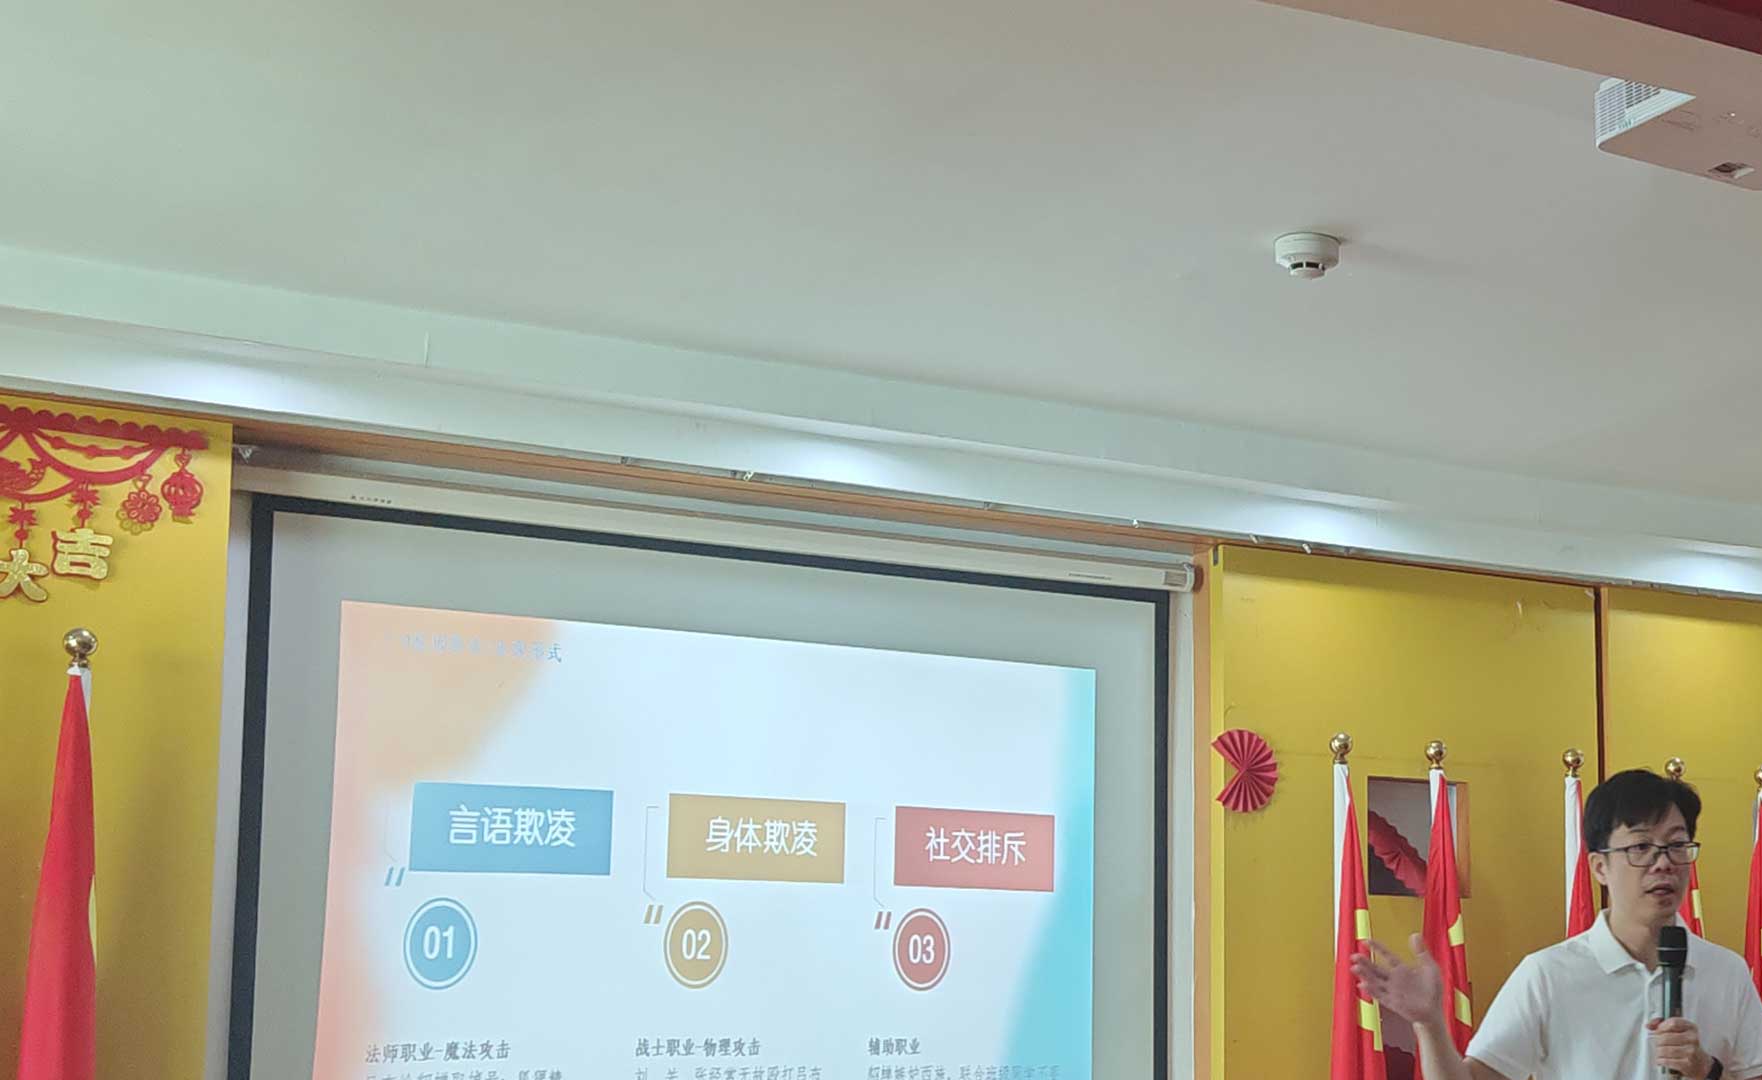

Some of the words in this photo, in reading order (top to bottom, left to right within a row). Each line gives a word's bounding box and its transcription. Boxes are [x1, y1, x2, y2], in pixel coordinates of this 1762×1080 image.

[449, 804, 576, 848] 言语欺凌
[705, 815, 818, 857] 身体欺凌
[925, 826, 1026, 866] 社交排斥
[422, 925, 455, 960] 01
[681, 928, 712, 961] 02
[908, 934, 935, 964] 03
[868, 1037, 921, 1056] 辅助职业
